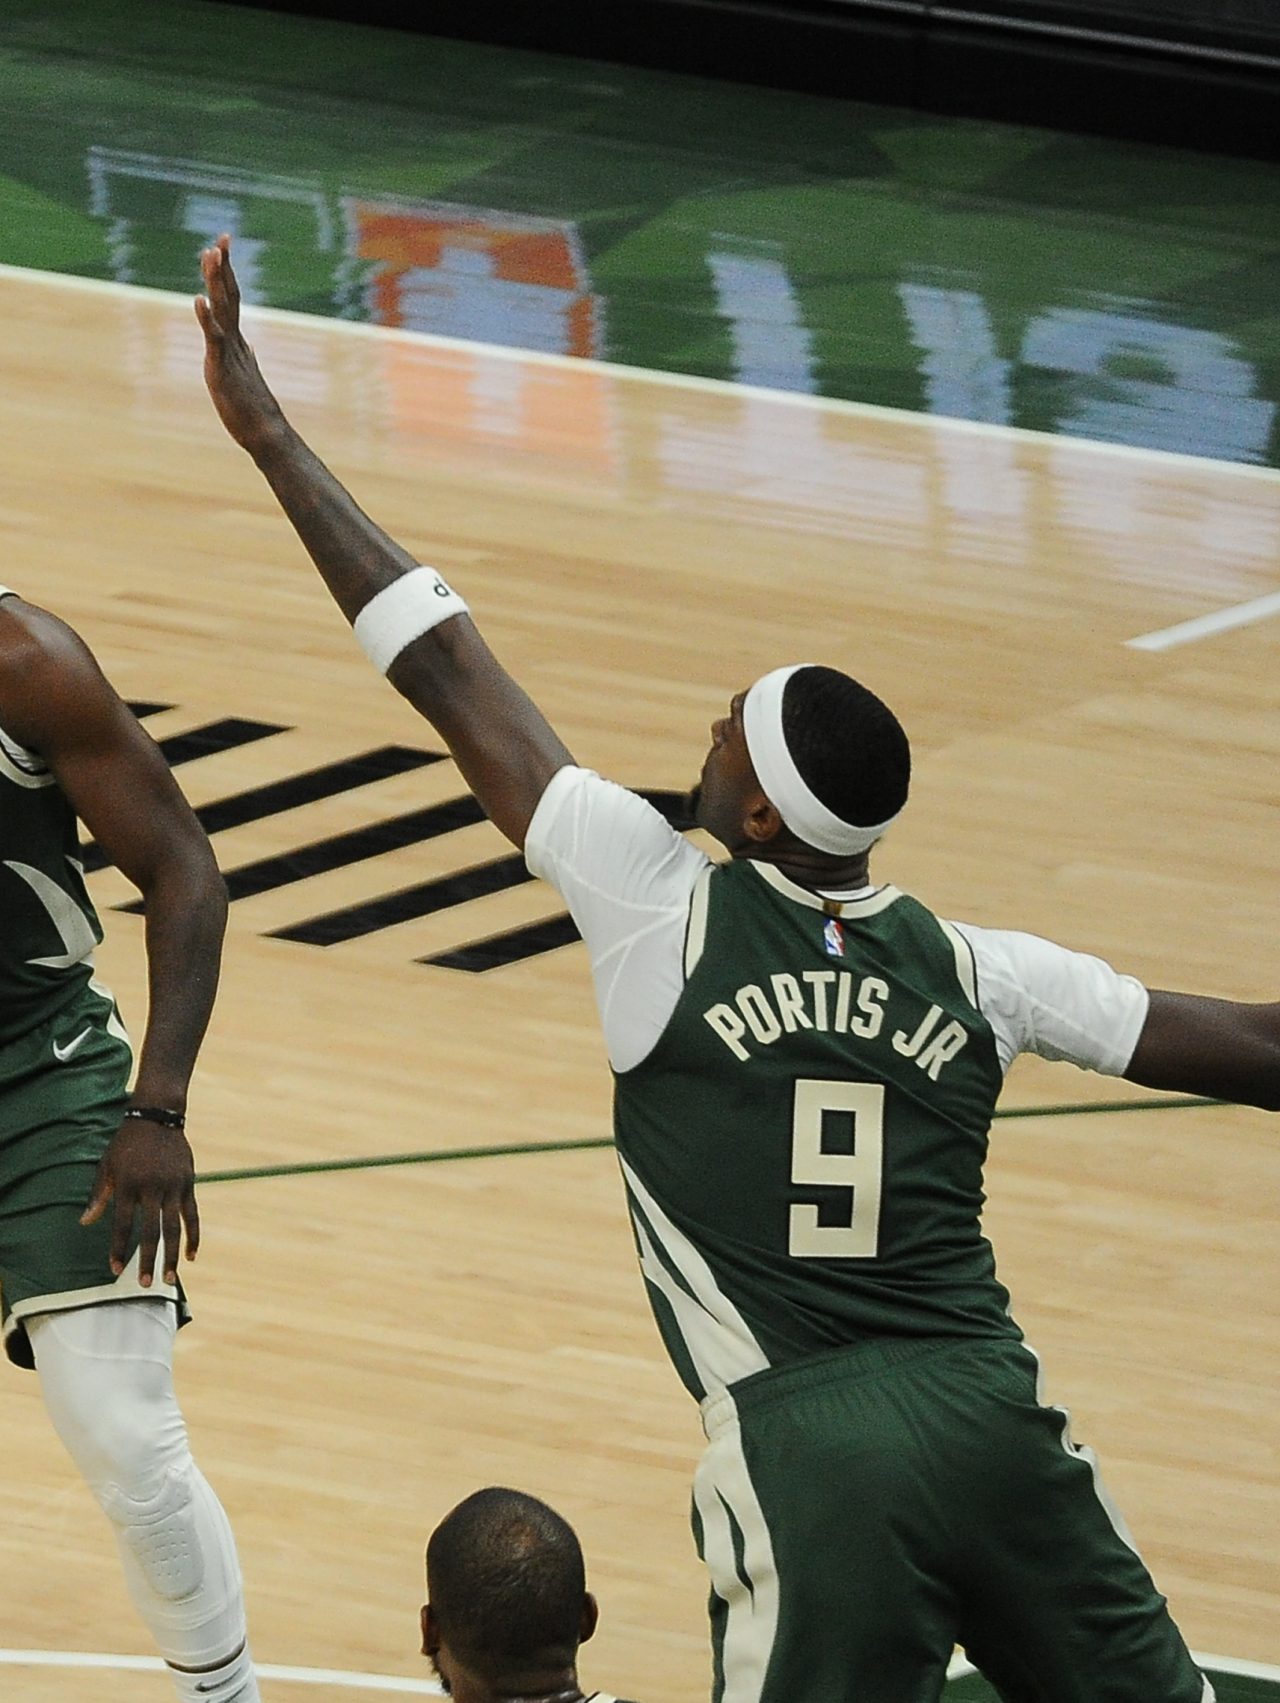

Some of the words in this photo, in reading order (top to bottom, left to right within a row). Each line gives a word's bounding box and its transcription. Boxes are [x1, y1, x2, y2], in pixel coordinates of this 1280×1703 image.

[703, 970, 890, 1062] PORTIS
[891, 1004, 969, 1082] JR
[788, 1078, 886, 1258] 9
